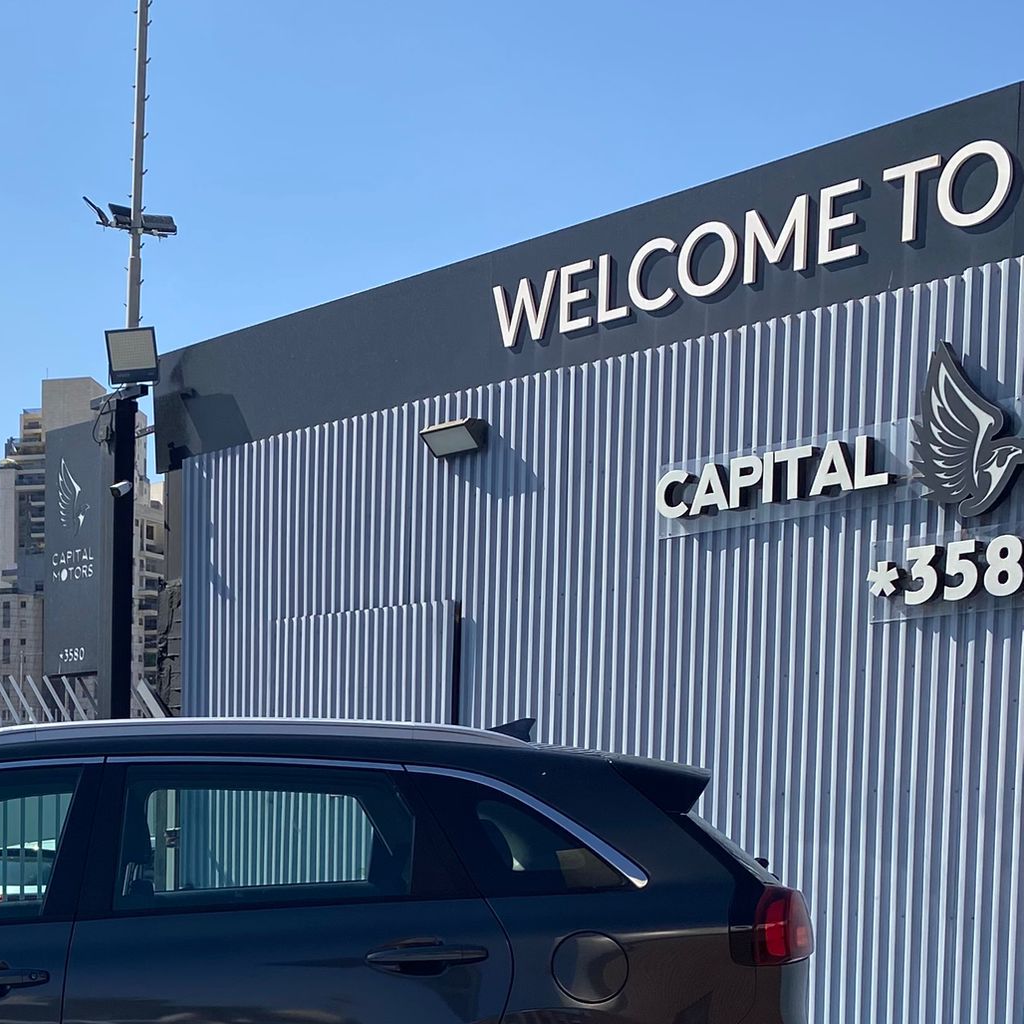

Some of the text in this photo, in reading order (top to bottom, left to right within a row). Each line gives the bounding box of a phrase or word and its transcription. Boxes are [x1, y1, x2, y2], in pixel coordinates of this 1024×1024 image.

[492, 139, 1014, 348] WELCOME TO
[655, 435, 889, 519] CAPITAL
[52, 547, 94, 566] CAPITAL
[52, 564, 94, 582] MOTORS
